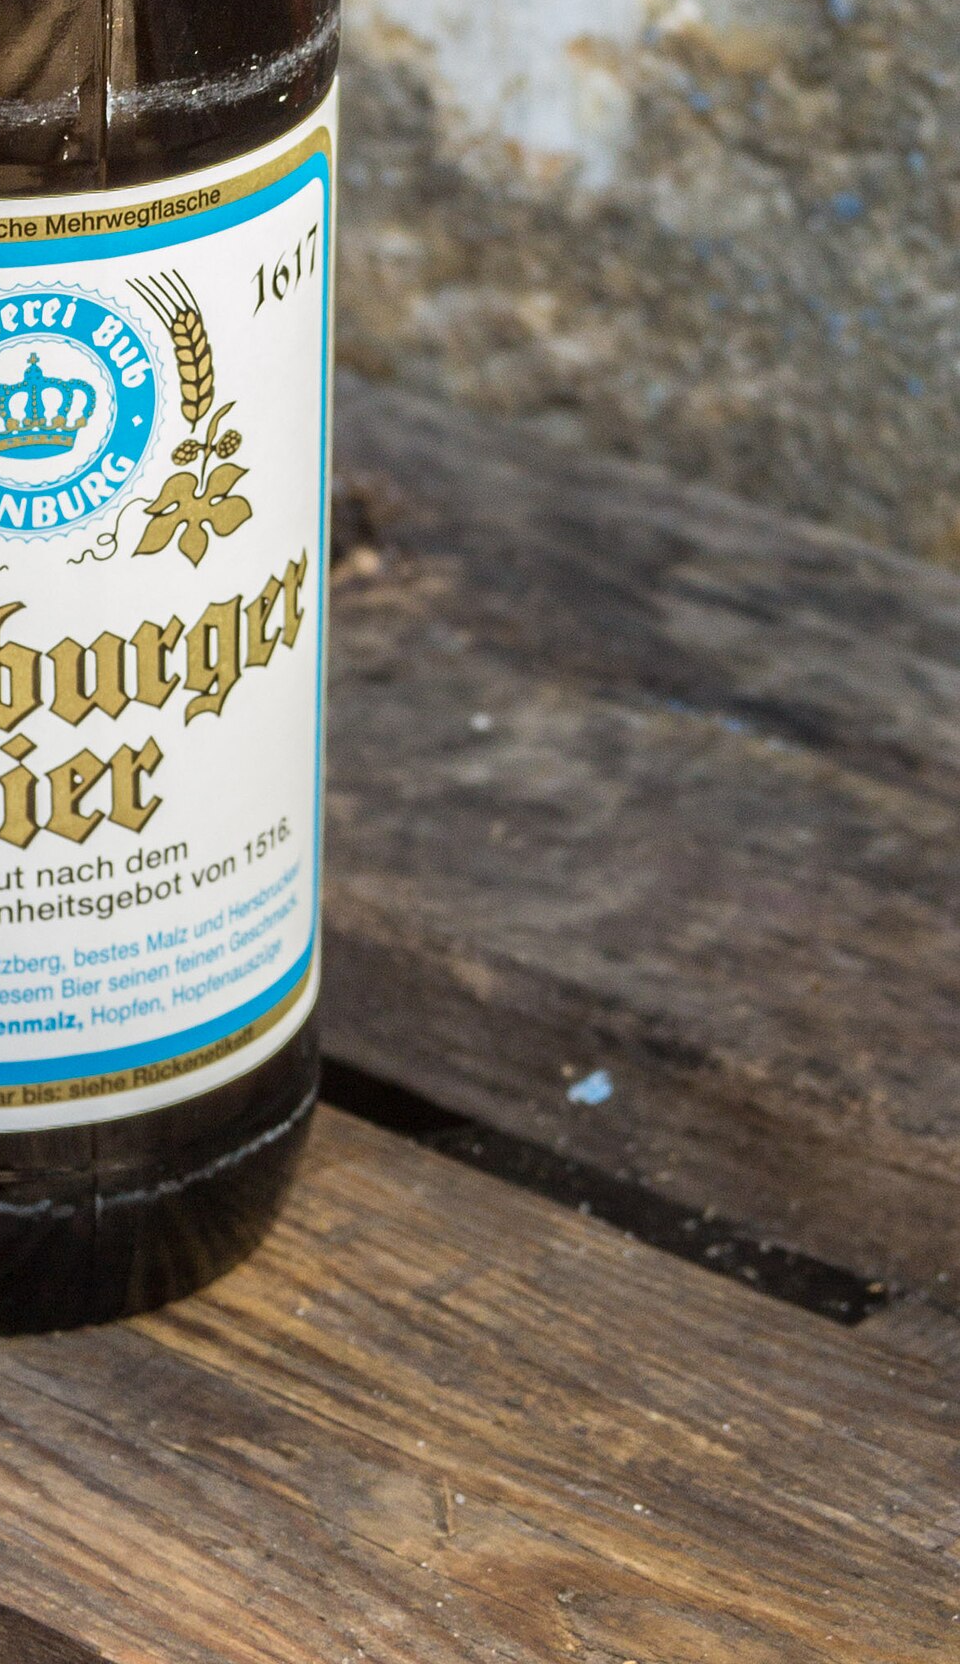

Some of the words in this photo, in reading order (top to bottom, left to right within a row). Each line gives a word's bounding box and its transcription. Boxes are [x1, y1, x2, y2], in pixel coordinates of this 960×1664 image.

[45, 187, 221, 238] Mehrwegflasche
[251, 222, 319, 318] 1617
[91, 314, 155, 390] Bub
[37, 856, 114, 888] nach
[126, 841, 188, 874] dem
[191, 855, 236, 889] von
[243, 816, 292, 866] 1516.
[73, 940, 140, 969] bestes
[146, 926, 188, 953] Malz
[193, 907, 224, 938] und
[61, 975, 101, 1001] Bier
[108, 963, 170, 993] seinen
[175, 941, 225, 974] feinen
[90, 1000, 166, 1028] Hopfen,
[22, 1083, 63, 1104] bis:
[68, 1078, 127, 1099] siehe
